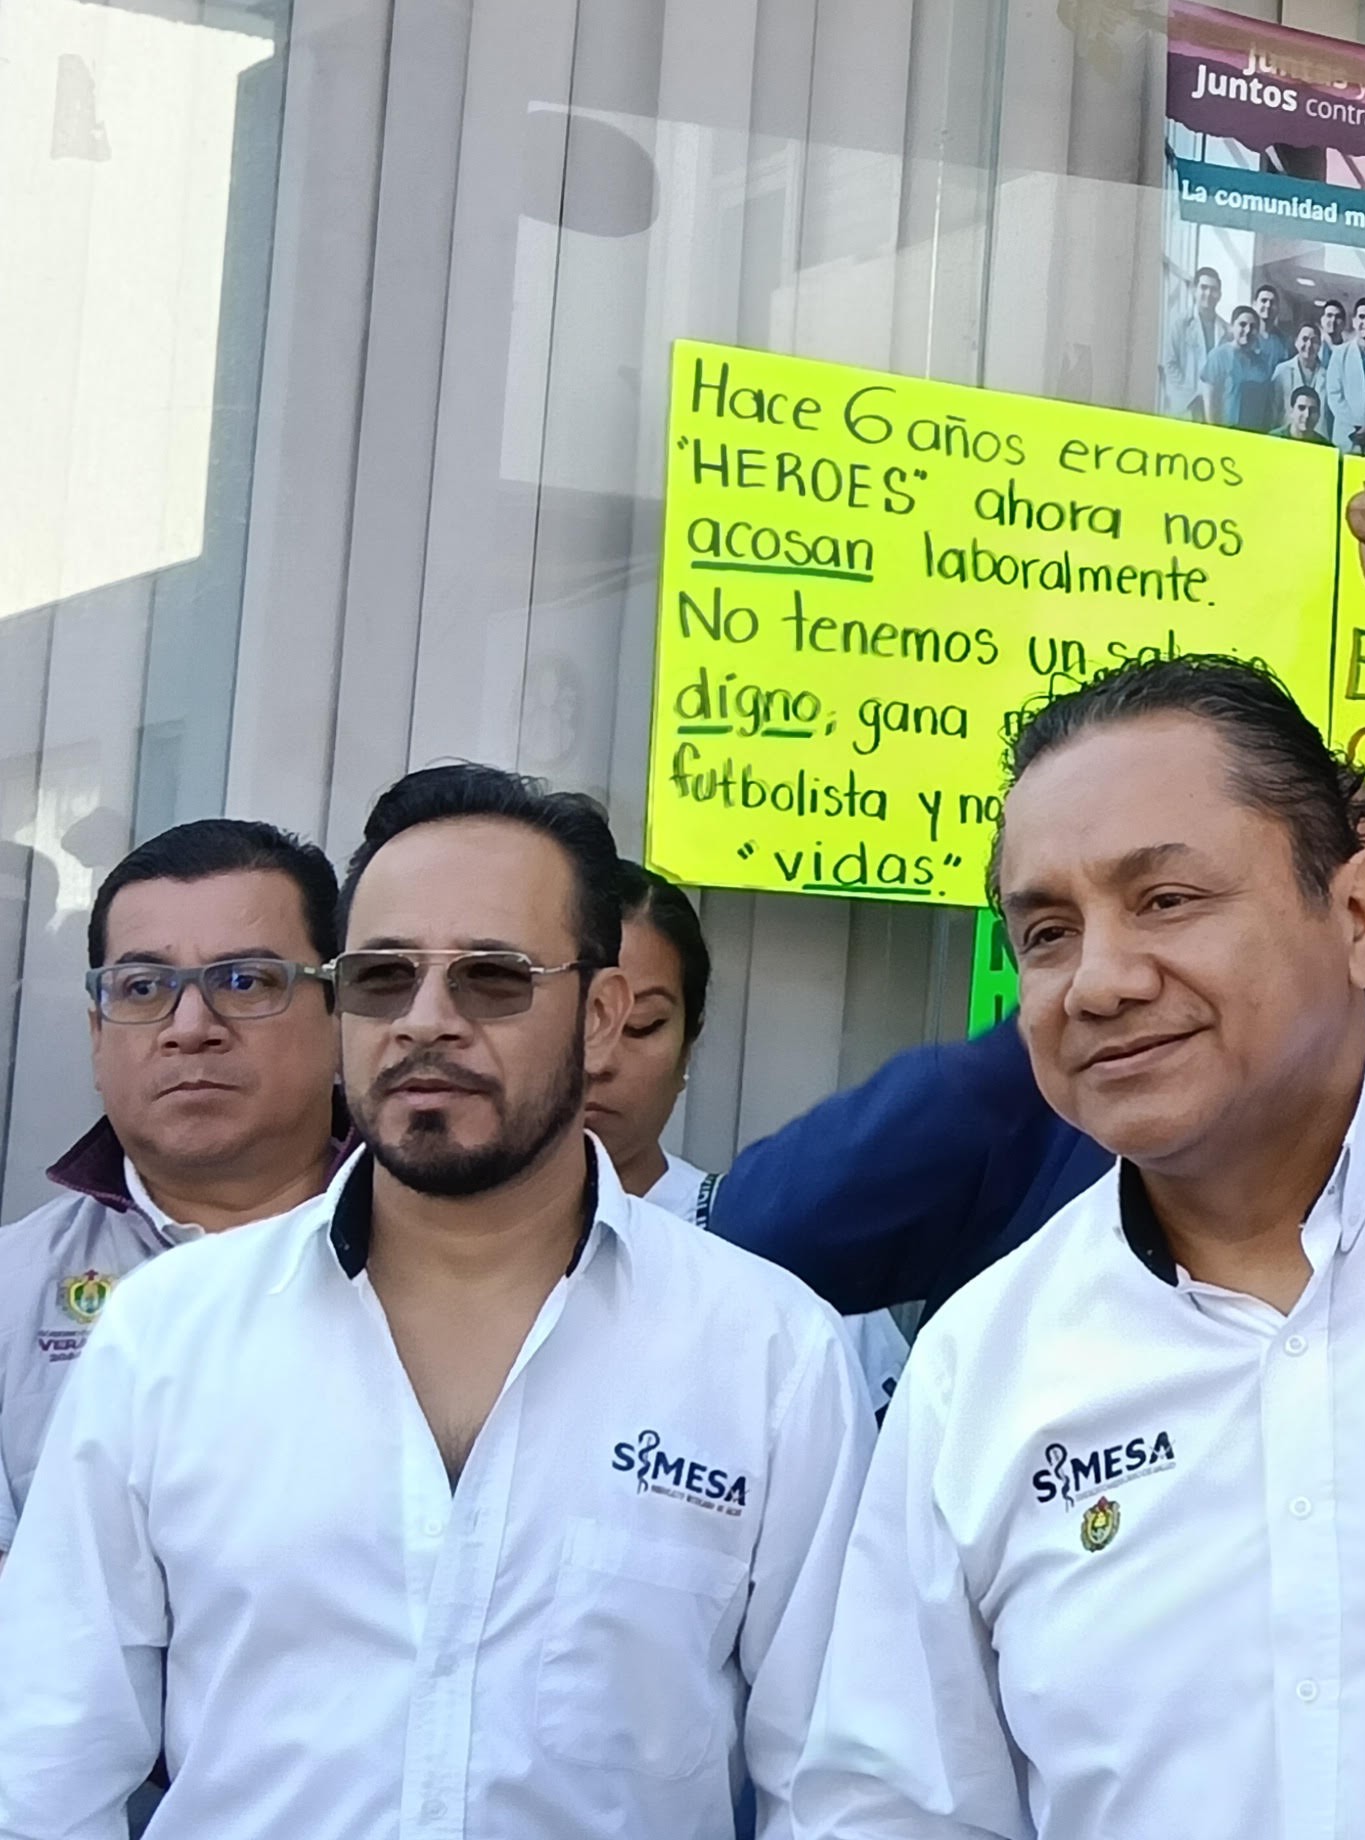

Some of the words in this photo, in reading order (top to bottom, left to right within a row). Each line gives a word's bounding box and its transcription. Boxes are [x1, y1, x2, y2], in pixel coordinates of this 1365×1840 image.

[1192, 64, 1298, 112] Juntos
[1181, 179, 1208, 202] La
[1214, 187, 1338, 223] comunidad
[690, 358, 822, 433] Hace
[843, 385, 897, 446] 6
[906, 413, 1027, 468] años
[1058, 436, 1245, 488] eramos
[974, 479, 1122, 540] ahora
[1163, 511, 1244, 558] nos
[686, 514, 875, 573] acosan
[924, 530, 1216, 609] laboralmente.
[678, 588, 760, 644] No
[781, 590, 1001, 666] tenemos
[1027, 633, 1087, 677] un
[852, 697, 968, 755] gana
[669, 742, 888, 822] futbolista
[918, 789, 942, 843] y
